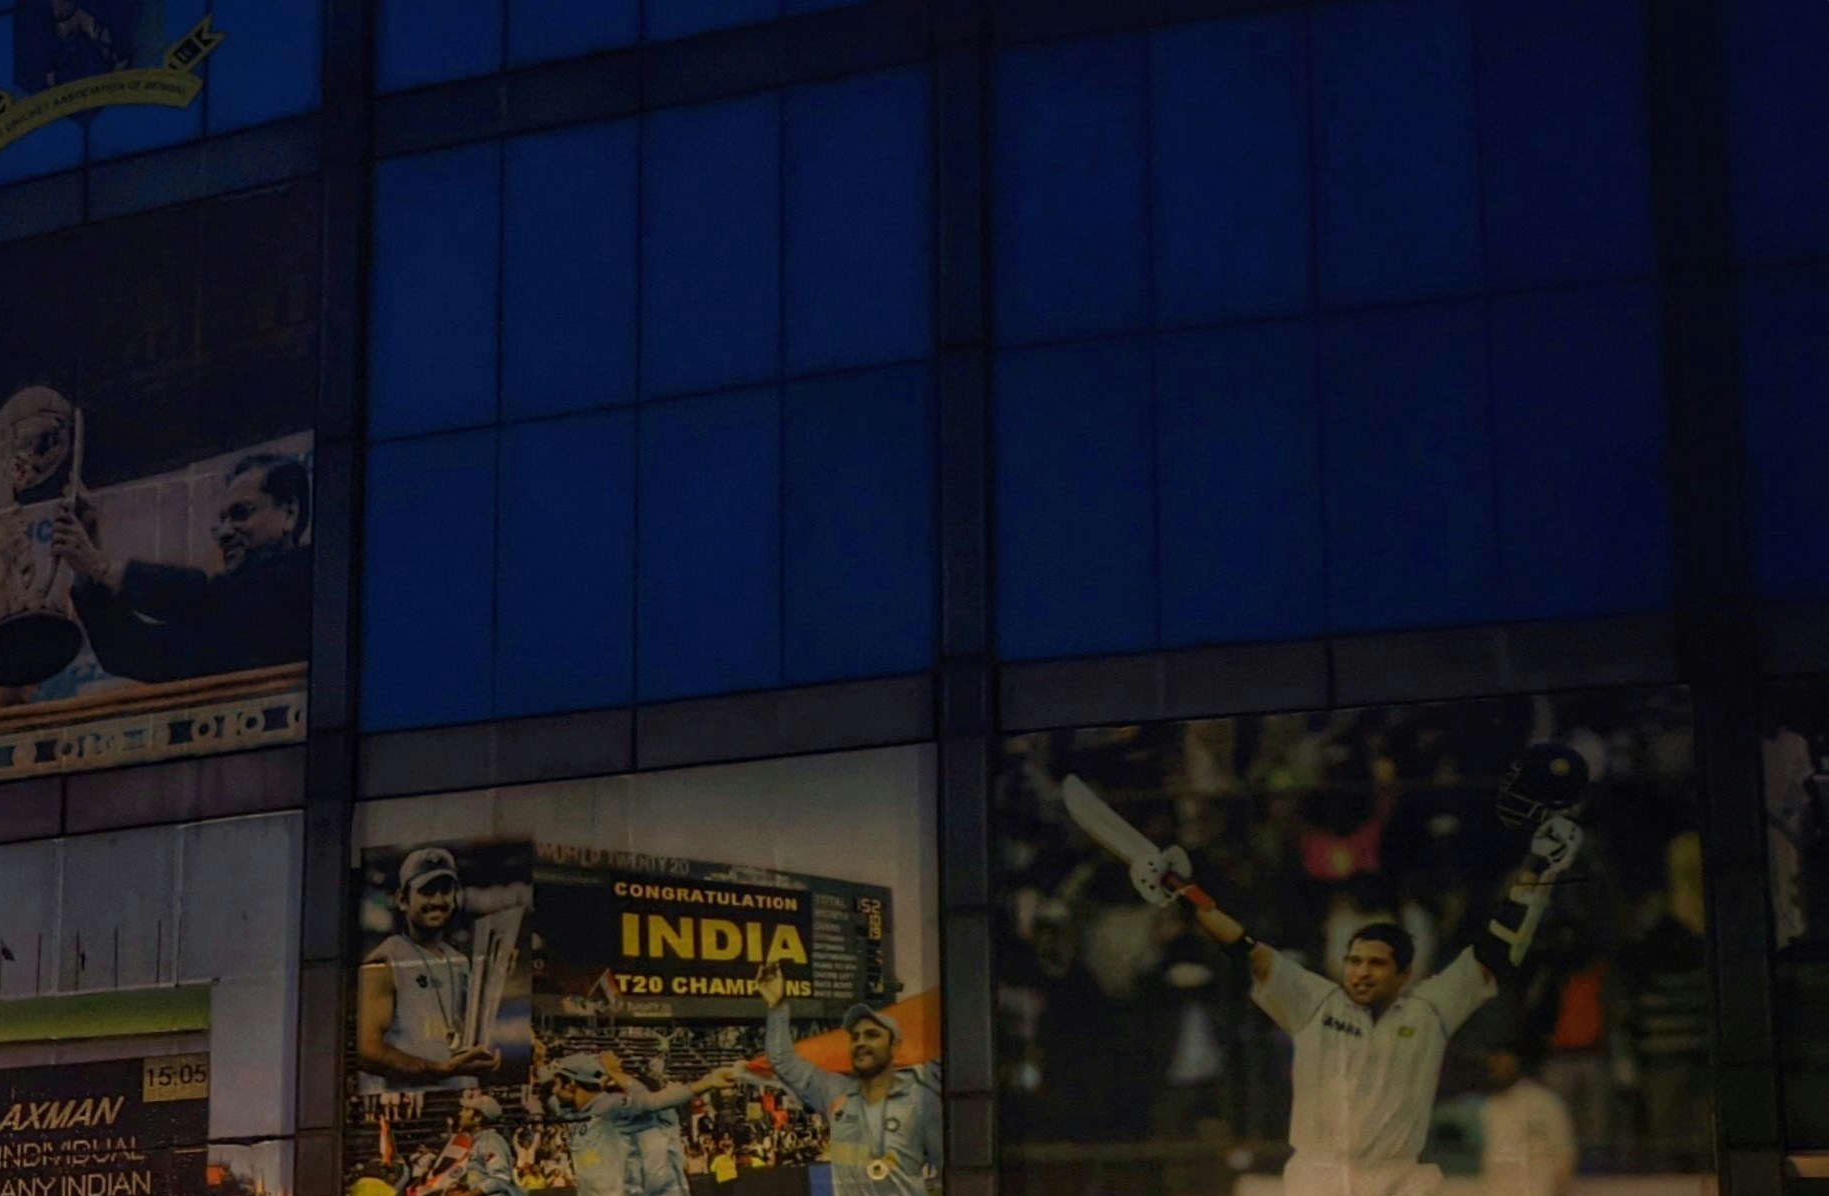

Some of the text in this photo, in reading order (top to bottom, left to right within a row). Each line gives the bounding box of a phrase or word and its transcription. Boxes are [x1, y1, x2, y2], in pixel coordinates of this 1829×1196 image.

[613, 880, 799, 912] CONGRATULATION
[620, 911, 810, 966] INDIA
[615, 973, 664, 994] T20
[671, 975, 813, 998] CHAMPNS
